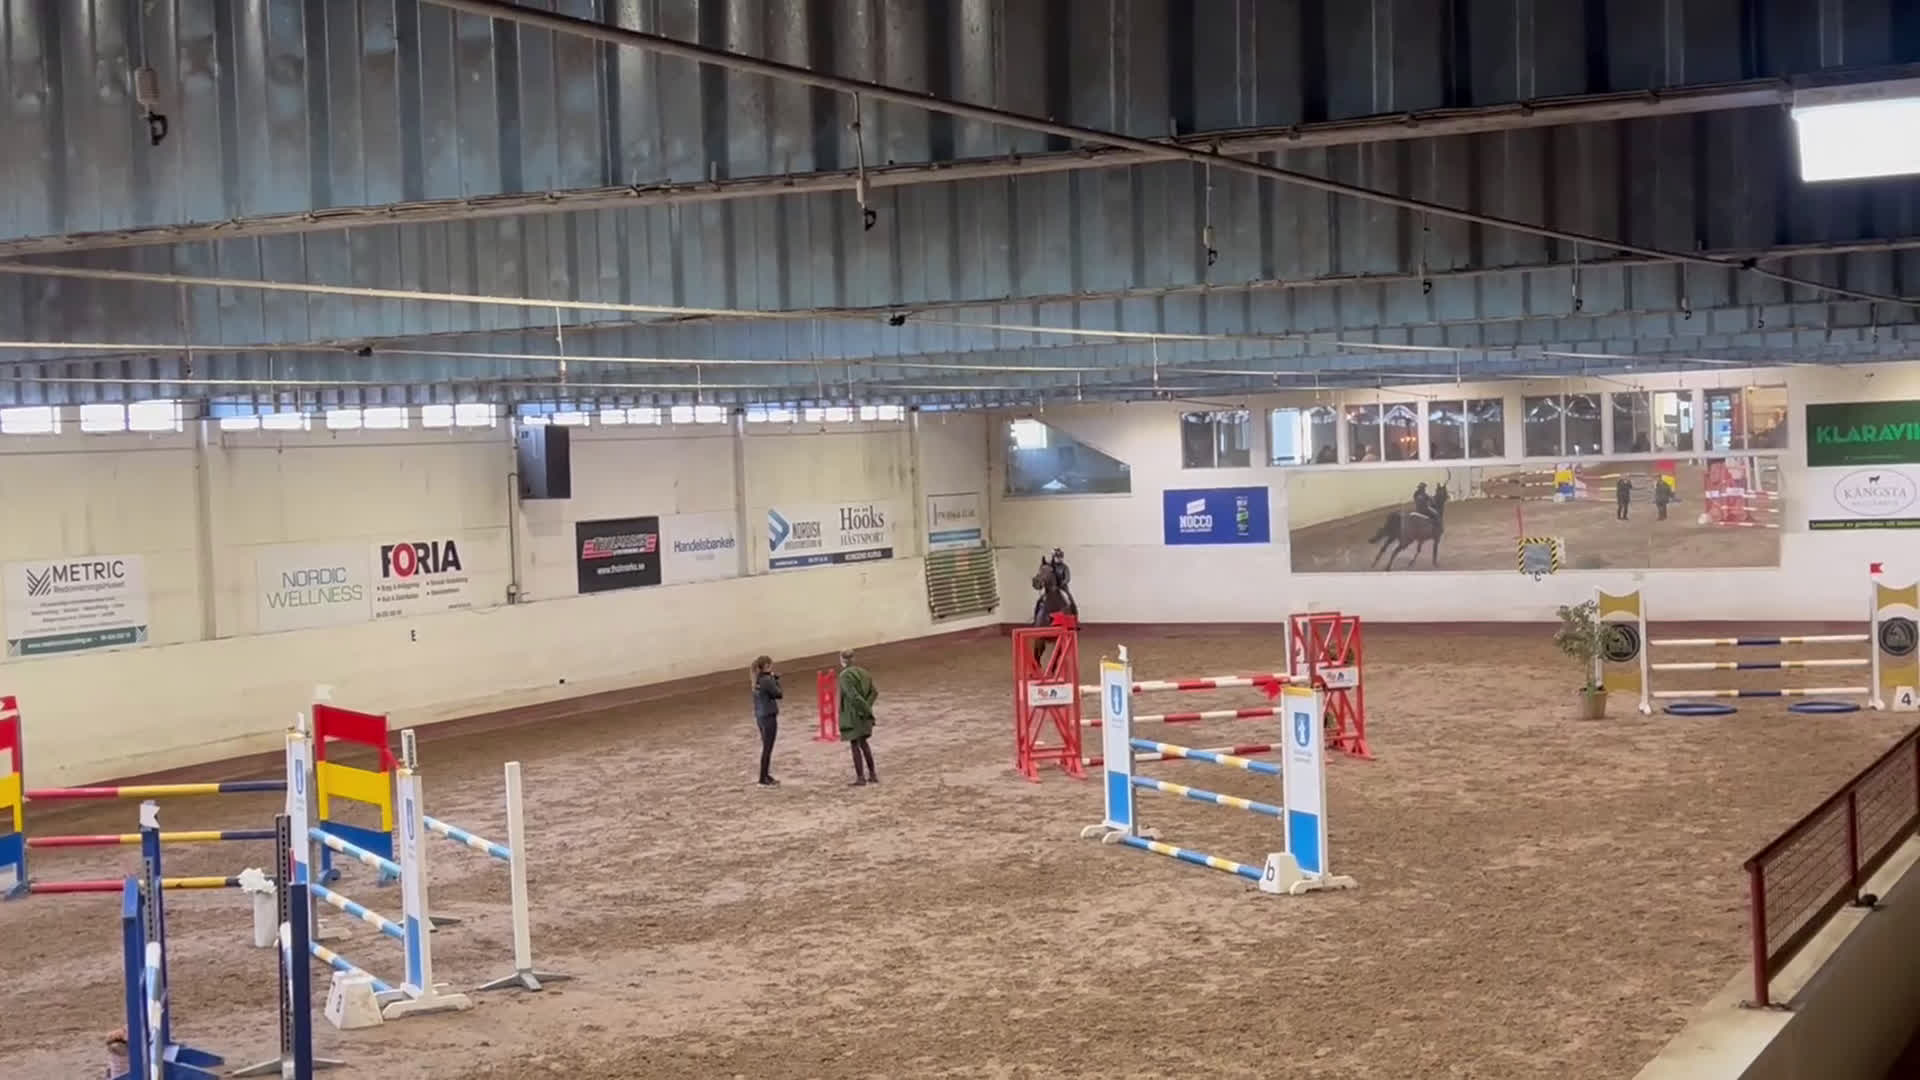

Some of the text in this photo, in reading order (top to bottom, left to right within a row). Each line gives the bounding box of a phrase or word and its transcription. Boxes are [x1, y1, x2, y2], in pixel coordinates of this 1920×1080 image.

[840, 505, 885, 531] Hööks
[1180, 515, 1213, 529] NOCCO
[674, 536, 735, 552] Handelsbanken
[381, 540, 462, 578] FORIA
[53, 561, 125, 583] METRIC
[282, 567, 346, 588] NORDIC
[267, 584, 363, 608] WELLNESS
[1901, 692, 1911, 706] 4
[1266, 860, 1276, 882] b
